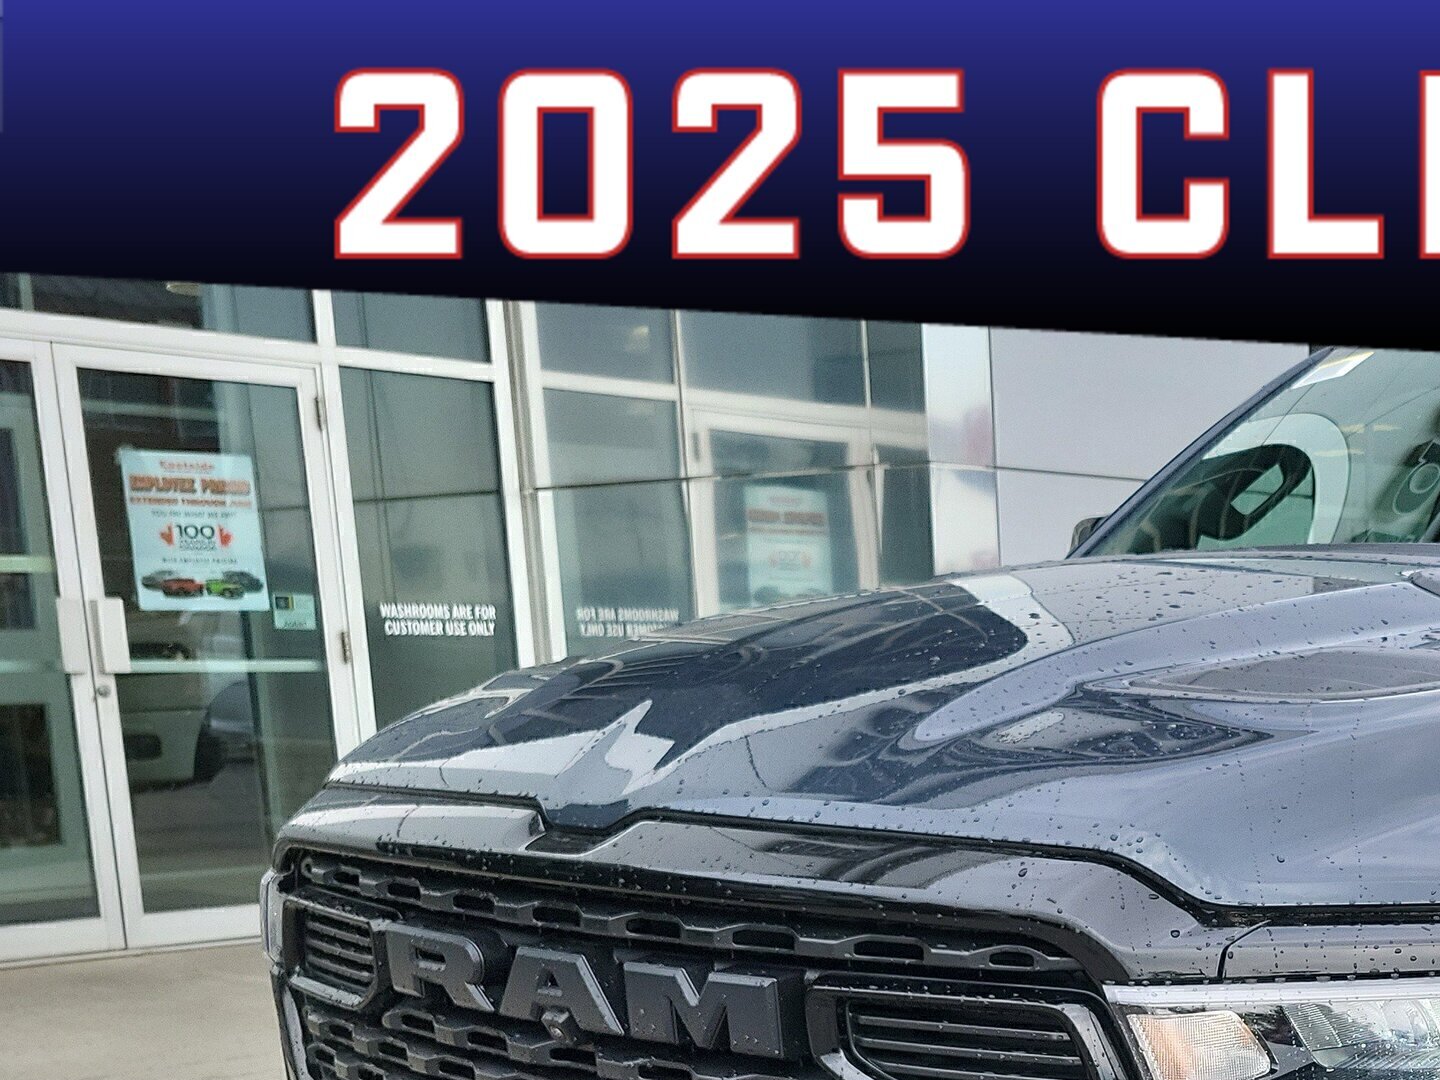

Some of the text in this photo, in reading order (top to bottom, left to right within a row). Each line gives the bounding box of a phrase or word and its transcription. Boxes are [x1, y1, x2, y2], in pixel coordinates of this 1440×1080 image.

[176, 524, 215, 540] 100
[379, 602, 496, 620] WASHROOMS ARE FOR
[384, 619, 495, 636] CUSTOMER USE ONLY
[385, 921, 784, 1058] RAM
